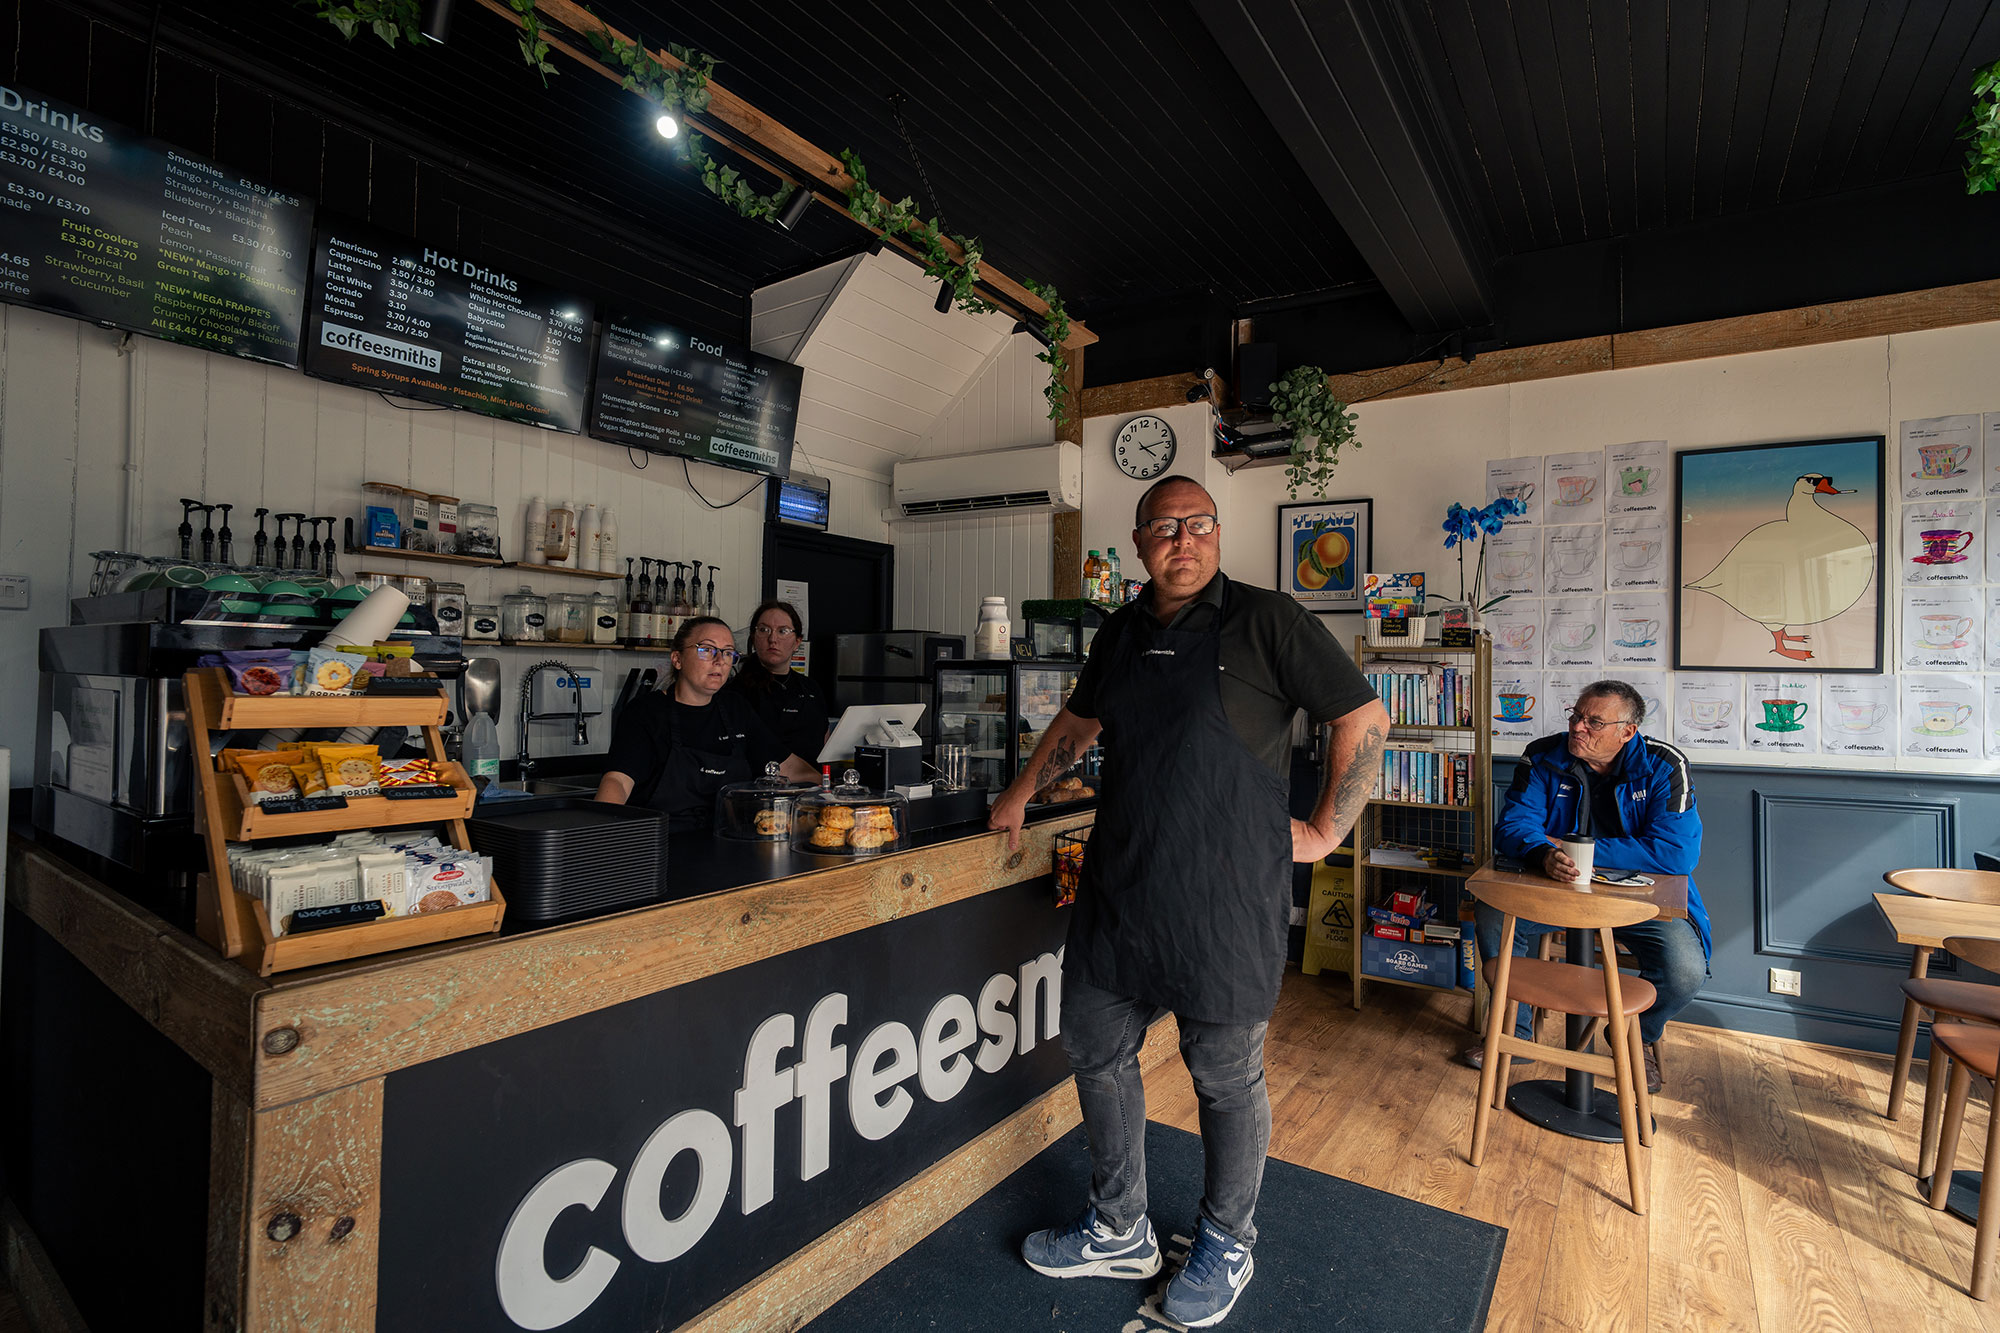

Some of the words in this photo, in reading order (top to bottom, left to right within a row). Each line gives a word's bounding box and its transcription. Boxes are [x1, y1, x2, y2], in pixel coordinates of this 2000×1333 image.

[0, 86, 104, 143] Drinks
[2, 122, 40, 142] £3.50
[52, 140, 88, 159] £3.80
[0, 136, 39, 156] £2.90
[51, 153, 86, 172] £3.30
[48, 167, 86, 186] £4.00
[166, 163, 202, 183] Mango
[212, 181, 249, 201] Passion
[167, 150, 223, 179] Smoothies
[239, 178, 267, 195] £3.95
[8, 182, 45, 201] £3.30
[56, 198, 91, 215] £3.70
[165, 176, 223, 205] Strawberry
[232, 201, 268, 220] Banana
[162, 210, 185, 225] Iced
[188, 218, 211, 233] Teas
[164, 189, 216, 215] Blueberry
[225, 211, 276, 235] Blackberry
[62, 218, 91, 235] Fruit
[94, 228, 139, 249] Coolers
[160, 222, 193, 240] Peach
[232, 233, 259, 249] £3.30
[61, 232, 95, 249] £3.30
[105, 245, 137, 261] £3.70
[159, 235, 195, 254] Lemon
[205, 249, 243, 268] Passion
[329, 236, 379, 258] Americano
[417, 265, 436, 277] 3.20
[75, 249, 122, 270] Tropical
[328, 248, 382, 271] Cappuccino
[391, 267, 410, 279] 3.50
[416, 275, 435, 287] 3.80
[423, 248, 459, 273] Hot
[462, 261, 518, 293] Drinks
[118, 274, 144, 290] Basil
[156, 260, 190, 277] Green
[191, 270, 210, 283] Tea
[196, 259, 230, 276] Mango
[239, 271, 275, 290] Passion
[328, 259, 352, 273] Latte
[390, 278, 409, 290] 3.50
[415, 286, 434, 298] 3.80
[70, 275, 131, 298] Cucumber
[326, 282, 363, 299] Cortado
[388, 300, 407, 311] 3.10
[327, 270, 345, 282] Flat
[346, 276, 373, 290] White
[389, 289, 408, 301] 3.30
[470, 282, 485, 293] Hot
[486, 287, 522, 305] Chocolate
[193, 291, 223, 306] MEGA
[469, 292, 491, 305] White
[492, 299, 506, 310] Hot
[506, 304, 542, 321] Chocolate
[152, 305, 191, 322] Crunch
[199, 319, 250, 337] Chocolate
[154, 293, 208, 316] Raspberry
[209, 307, 240, 324] Ripple
[247, 318, 281, 333] Biscoff
[323, 304, 364, 321] Espresso
[385, 321, 404, 332] 2.20
[410, 327, 429, 339] 2.50
[325, 293, 356, 308] Mocha
[386, 310, 405, 322] 3.70
[411, 317, 431, 329] 4.00
[467, 312, 506, 330] Babyccino
[486, 308, 506, 320] Latte
[151, 318, 166, 329] All
[168, 322, 197, 336] £4.45
[205, 331, 234, 345] £4.95
[466, 322, 484, 333] Teas
[610, 323, 641, 338] Breakfast
[326, 331, 437, 368] coffeesmiths
[689, 336, 723, 357] Food
[463, 356, 486, 368] Extras
[351, 363, 380, 378] Spring
[381, 370, 410, 384] Syrups
[410, 377, 447, 392] Available
[602, 393, 638, 408] Homemade
[1130, 424, 1137, 433] 11
[1139, 419, 1149, 428] 12
[1161, 429, 1168, 437] 2
[1121, 434, 1132, 442] 10
[1164, 441, 1171, 449] 3
[712, 442, 776, 464] coffeesmiths
[1118, 446, 1126, 455] 9
[1122, 458, 1129, 466] 8
[1161, 453, 1168, 461] 4
[1130, 466, 1137, 474] 7
[1141, 468, 1149, 477] 6
[1153, 463, 1160, 471] 5
[1925, 487, 1969, 497] coffeesmiths
[1925, 659, 1968, 667] coffeesmiths
[1925, 746, 1969, 754] coffeesmiths
[341, 787, 380, 798] BORDER
[1321, 889, 1354, 899] CAUTION
